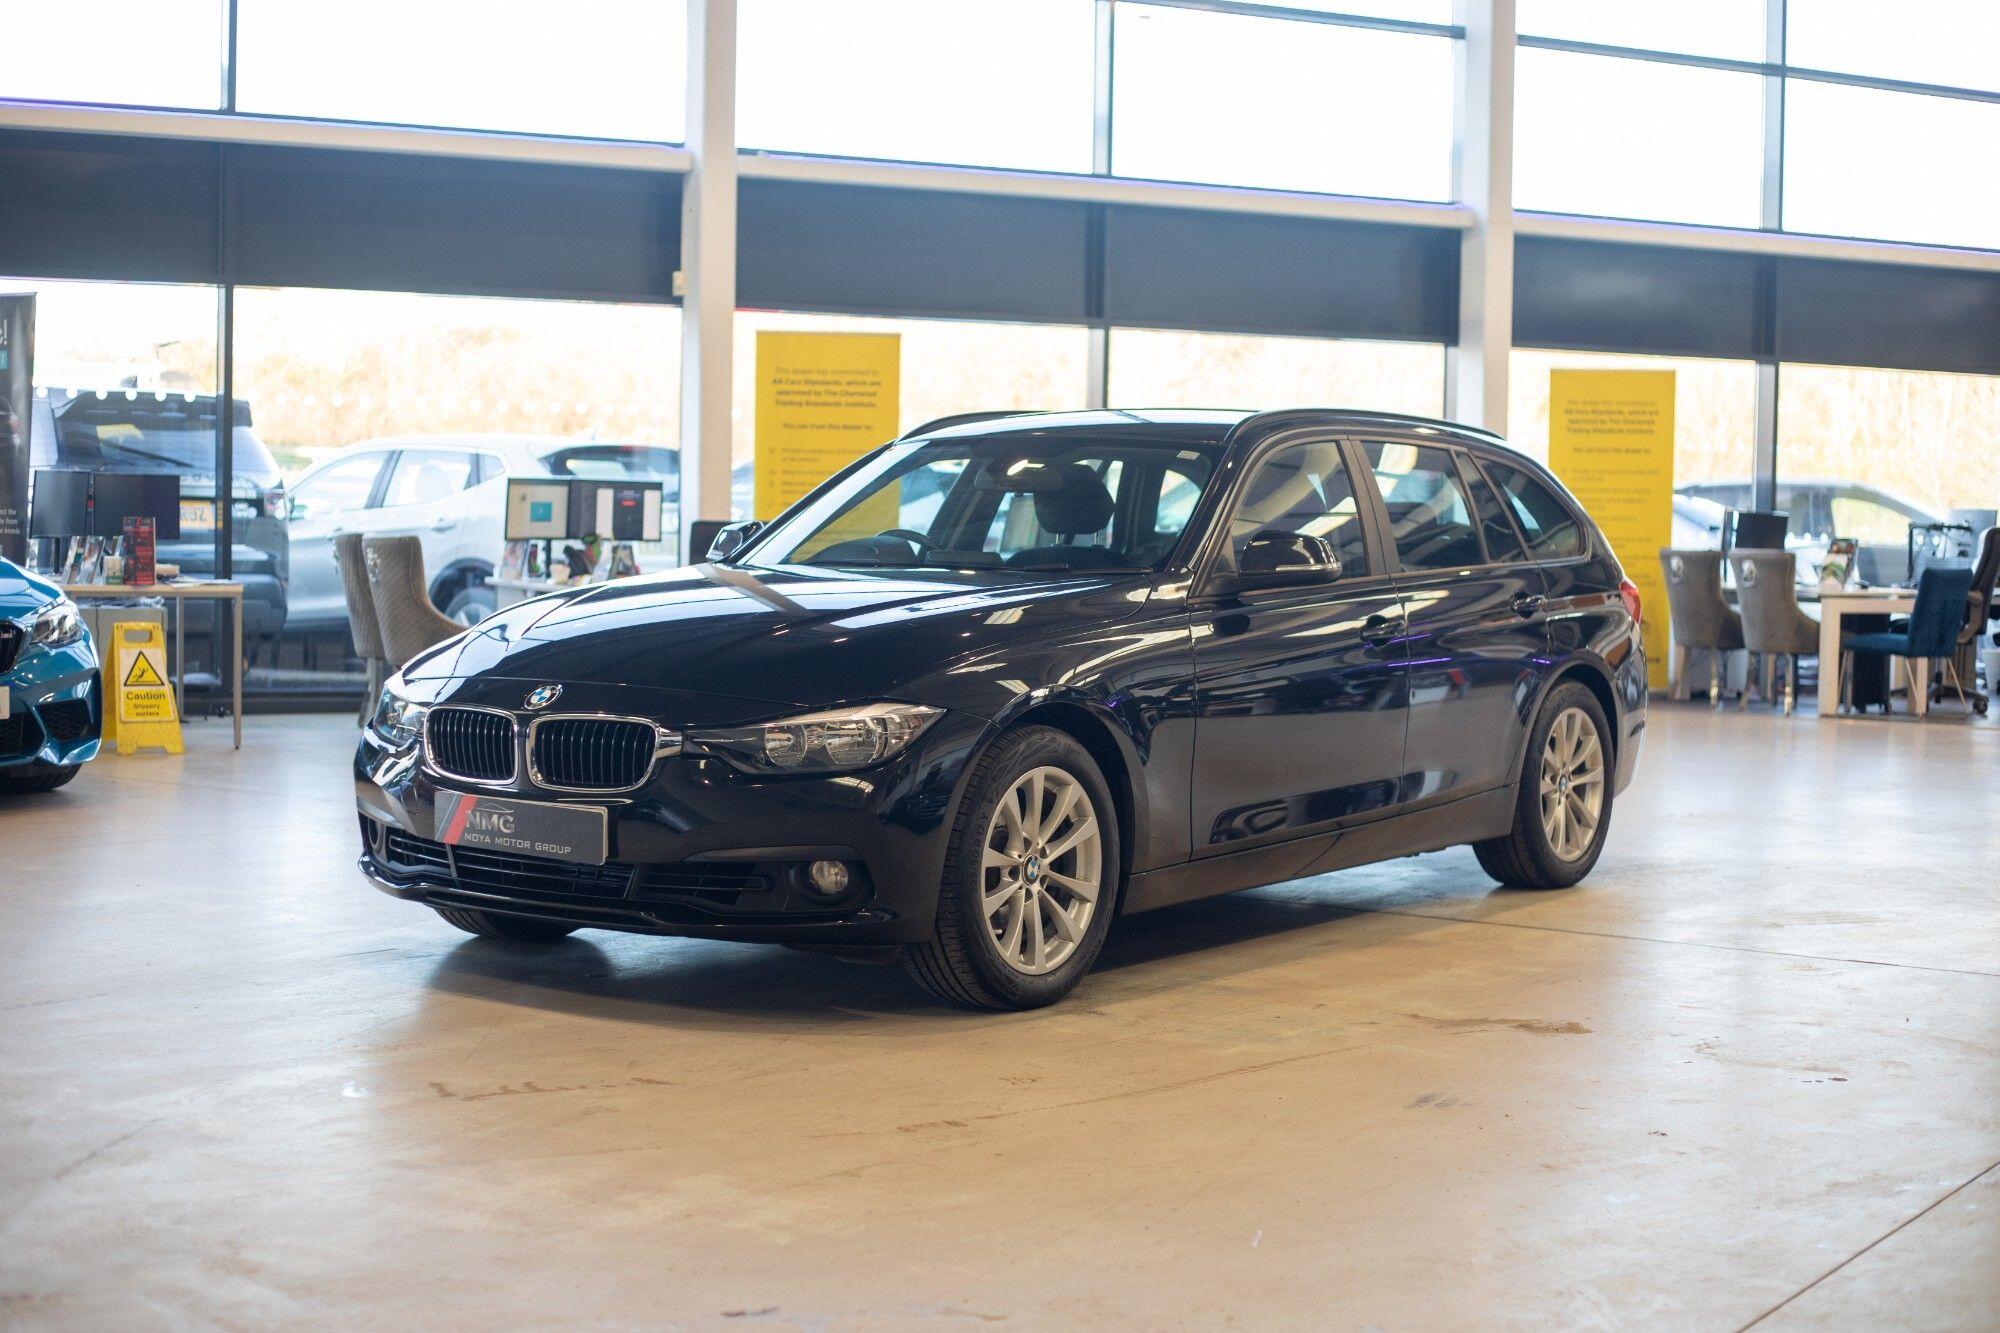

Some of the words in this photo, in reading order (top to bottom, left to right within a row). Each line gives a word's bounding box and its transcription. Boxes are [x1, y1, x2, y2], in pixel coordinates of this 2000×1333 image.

[126, 690, 166, 701] Caution
[464, 810, 515, 834] NMG
[464, 832, 492, 844] NOYA
[494, 836, 531, 849] MOTOR
[534, 842, 572, 855] GROUP
